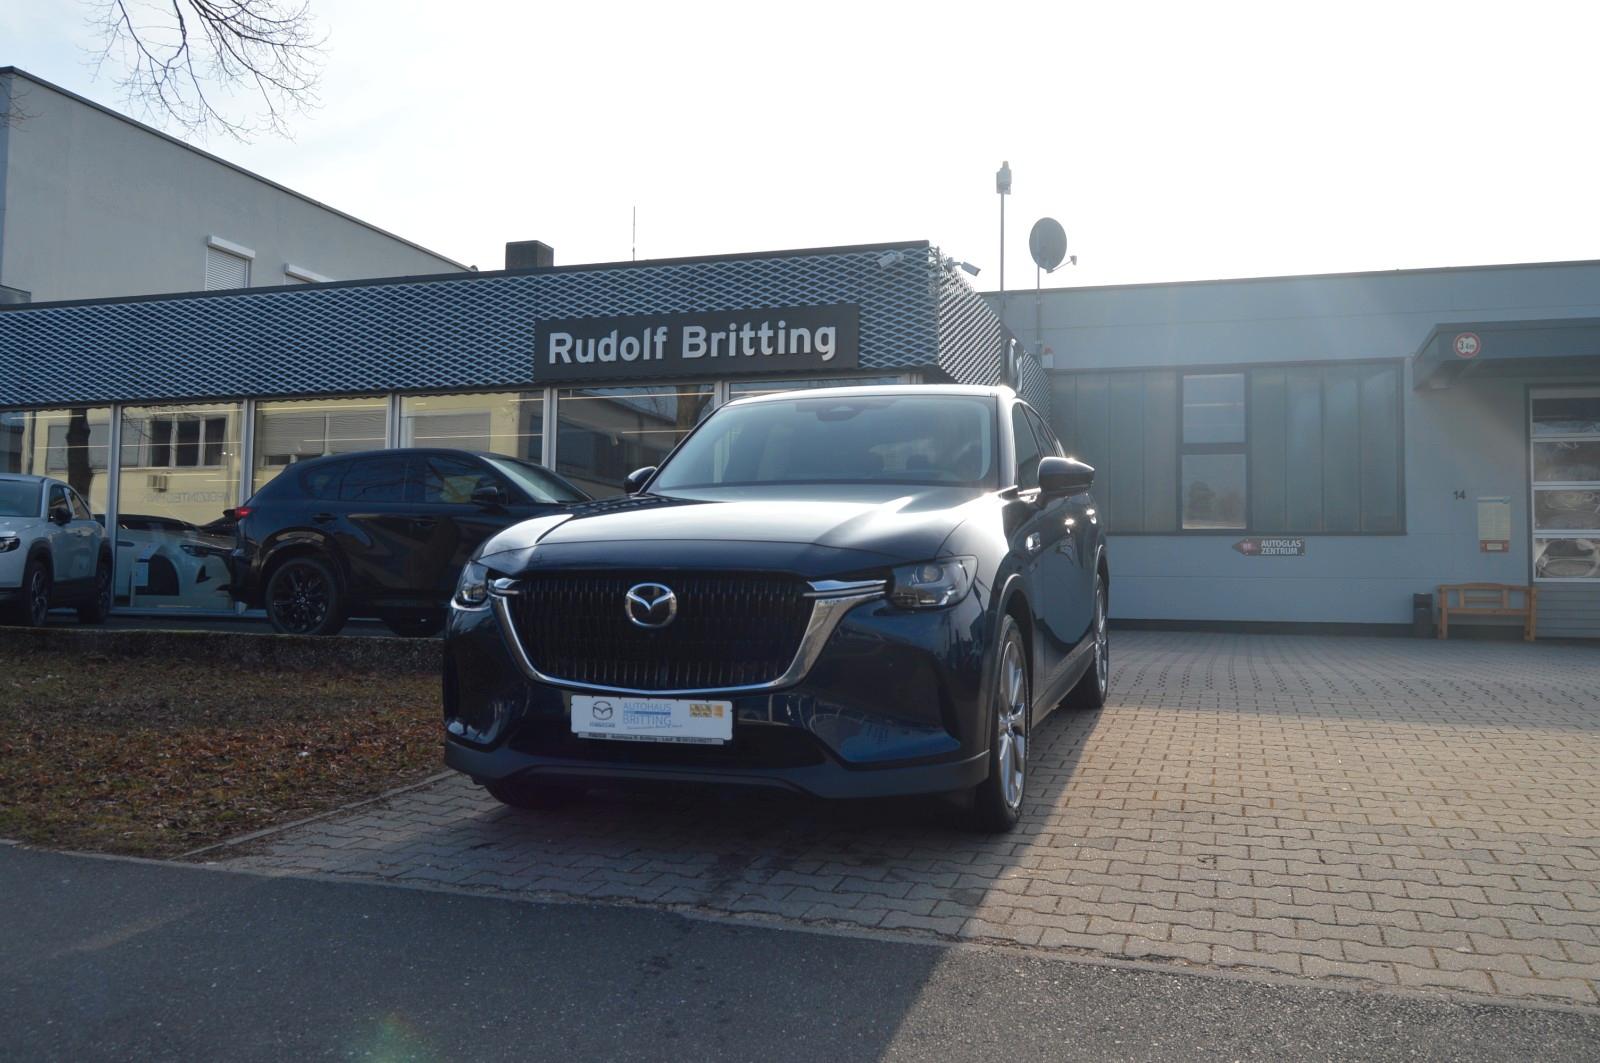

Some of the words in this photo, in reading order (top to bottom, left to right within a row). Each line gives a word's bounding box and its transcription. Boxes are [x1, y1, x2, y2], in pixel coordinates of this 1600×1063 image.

[549, 326, 667, 364] Rudolf
[682, 320, 836, 361] Britting
[1453, 489, 1466, 500] 14
[1261, 540, 1302, 548] AUTOGLAS
[1261, 547, 1298, 555] ZENTRUM
[623, 702, 672, 711] AUTOHAUS
[623, 714, 672, 727] BRITTING
